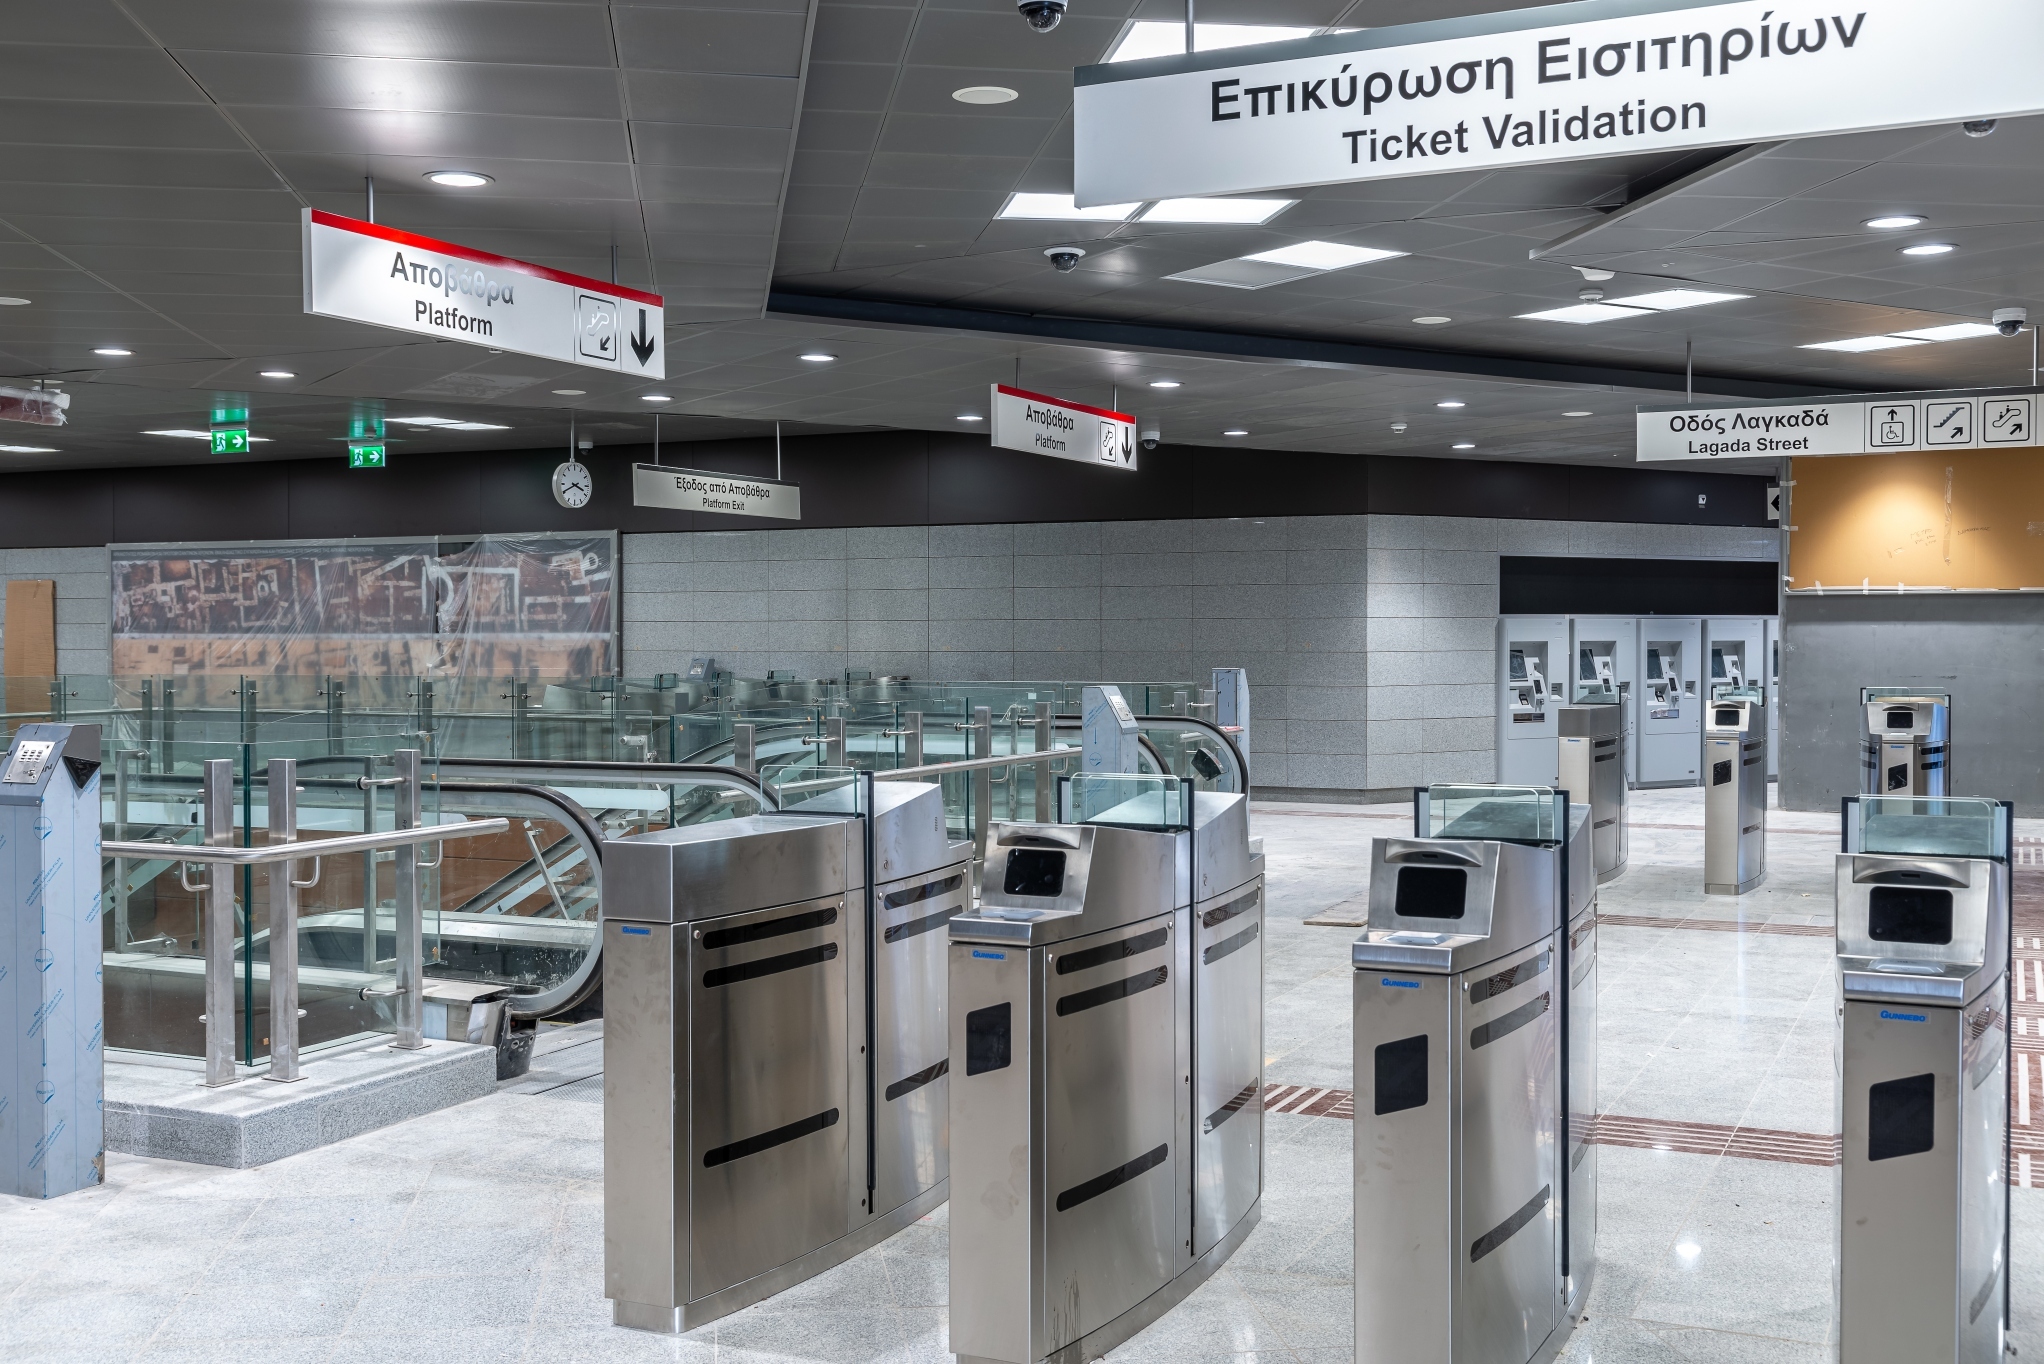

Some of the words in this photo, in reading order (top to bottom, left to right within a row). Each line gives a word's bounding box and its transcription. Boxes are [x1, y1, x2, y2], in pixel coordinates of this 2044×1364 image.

[1211, 56, 1514, 122] Επικύρωση
[1537, 10, 1867, 85] Εισιτηρίων
[1342, 119, 1469, 164] Ticket
[1482, 98, 1706, 150] Validation
[390, 251, 514, 306] Αποβάθρα
[415, 299, 493, 337] Platform
[1026, 404, 1073, 433] Αποβάθρα
[1669, 413, 1726, 435] Οδός
[1731, 409, 1829, 433] Λαγκαδά
[1035, 433, 1066, 452] Platform
[1688, 438, 1750, 456] Lagada
[1756, 436, 1809, 452] Street
[674, 476, 707, 495] Έξοδος
[709, 482, 727, 494] από
[728, 482, 770, 500] Αποβάθρα
[702, 498, 731, 510] Platform
[732, 500, 745, 511] Exit
[1381, 978, 1420, 989] GUNNEBO
[1880, 1010, 1926, 1022] GUNNEBO
